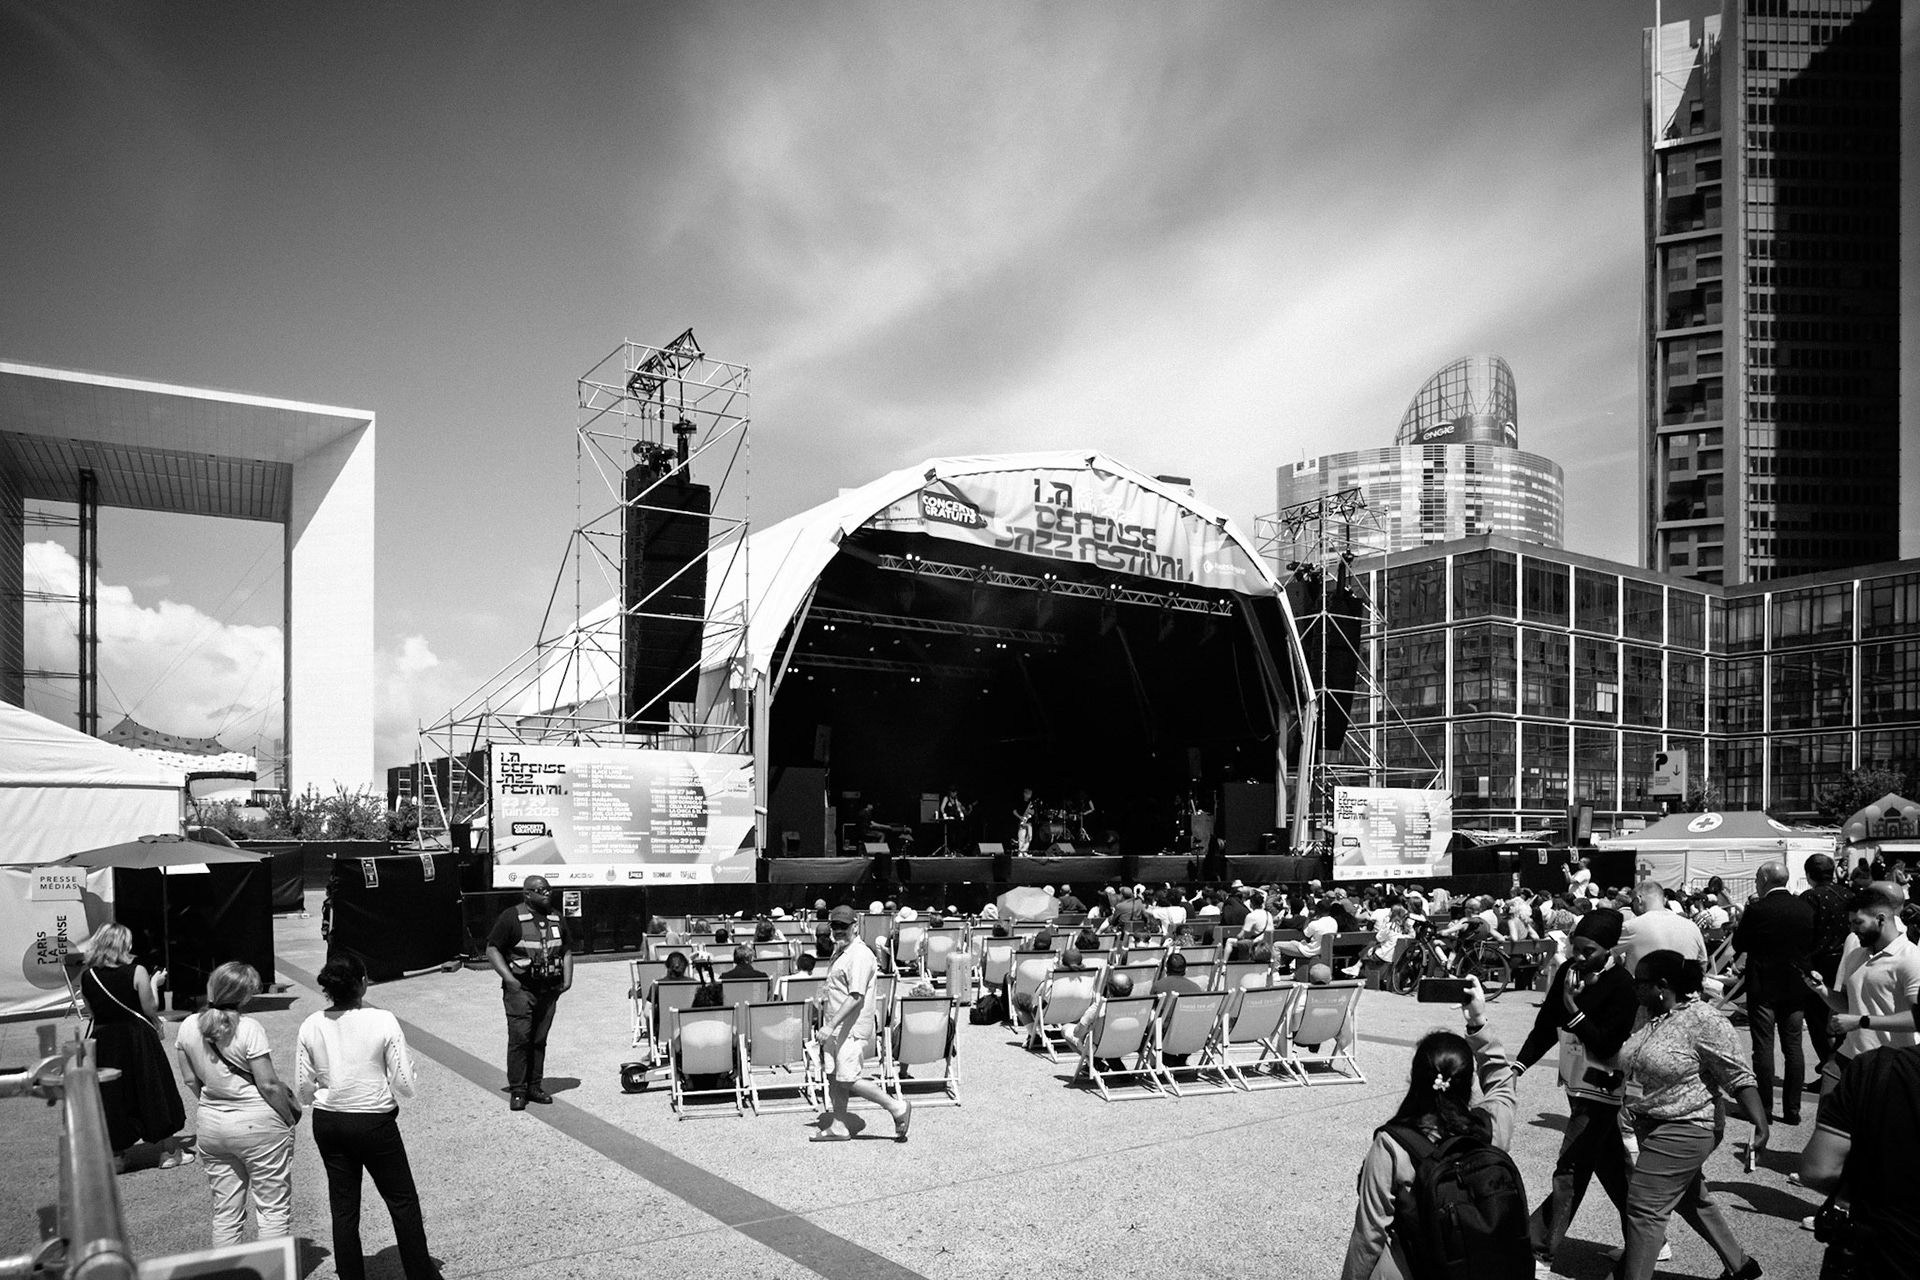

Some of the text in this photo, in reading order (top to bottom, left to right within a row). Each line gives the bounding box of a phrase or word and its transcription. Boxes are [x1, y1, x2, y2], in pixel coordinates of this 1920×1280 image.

[922, 495, 976, 514] CONCERTS
[925, 505, 976, 524] GRATUITS
[994, 525, 1194, 583] JAZZ FESTIVAL
[502, 806, 560, 819] juin 2025
[57, 915, 68, 958] EFENSE
[48, 949, 58, 964] LA
